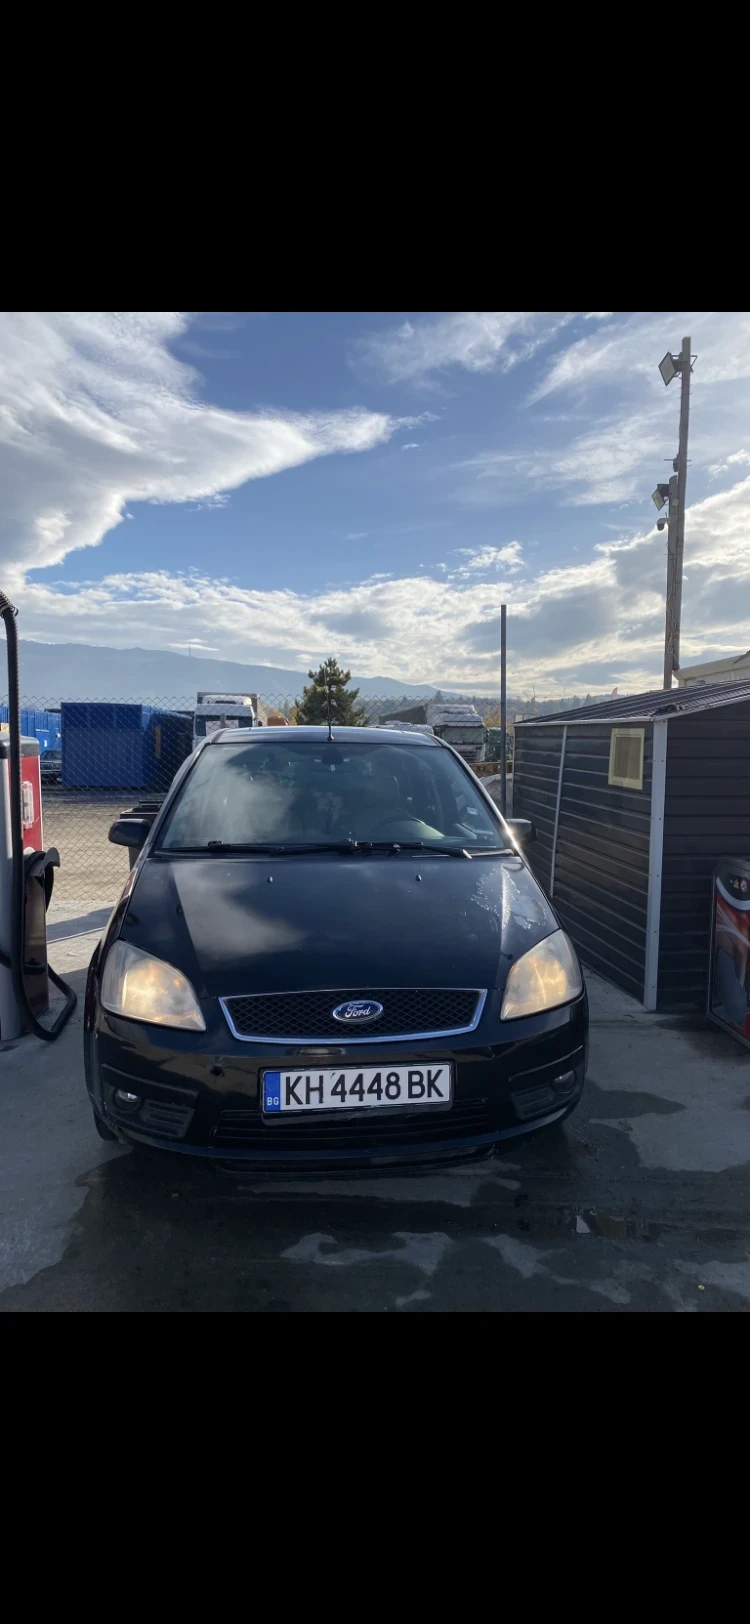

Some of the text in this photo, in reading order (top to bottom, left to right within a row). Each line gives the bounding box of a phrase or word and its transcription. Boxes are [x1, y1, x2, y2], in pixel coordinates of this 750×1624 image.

[345, 1003, 371, 1018] Ford
[285, 1069, 444, 1106] KH 4448 BK
[266, 1097, 279, 1106] BG
